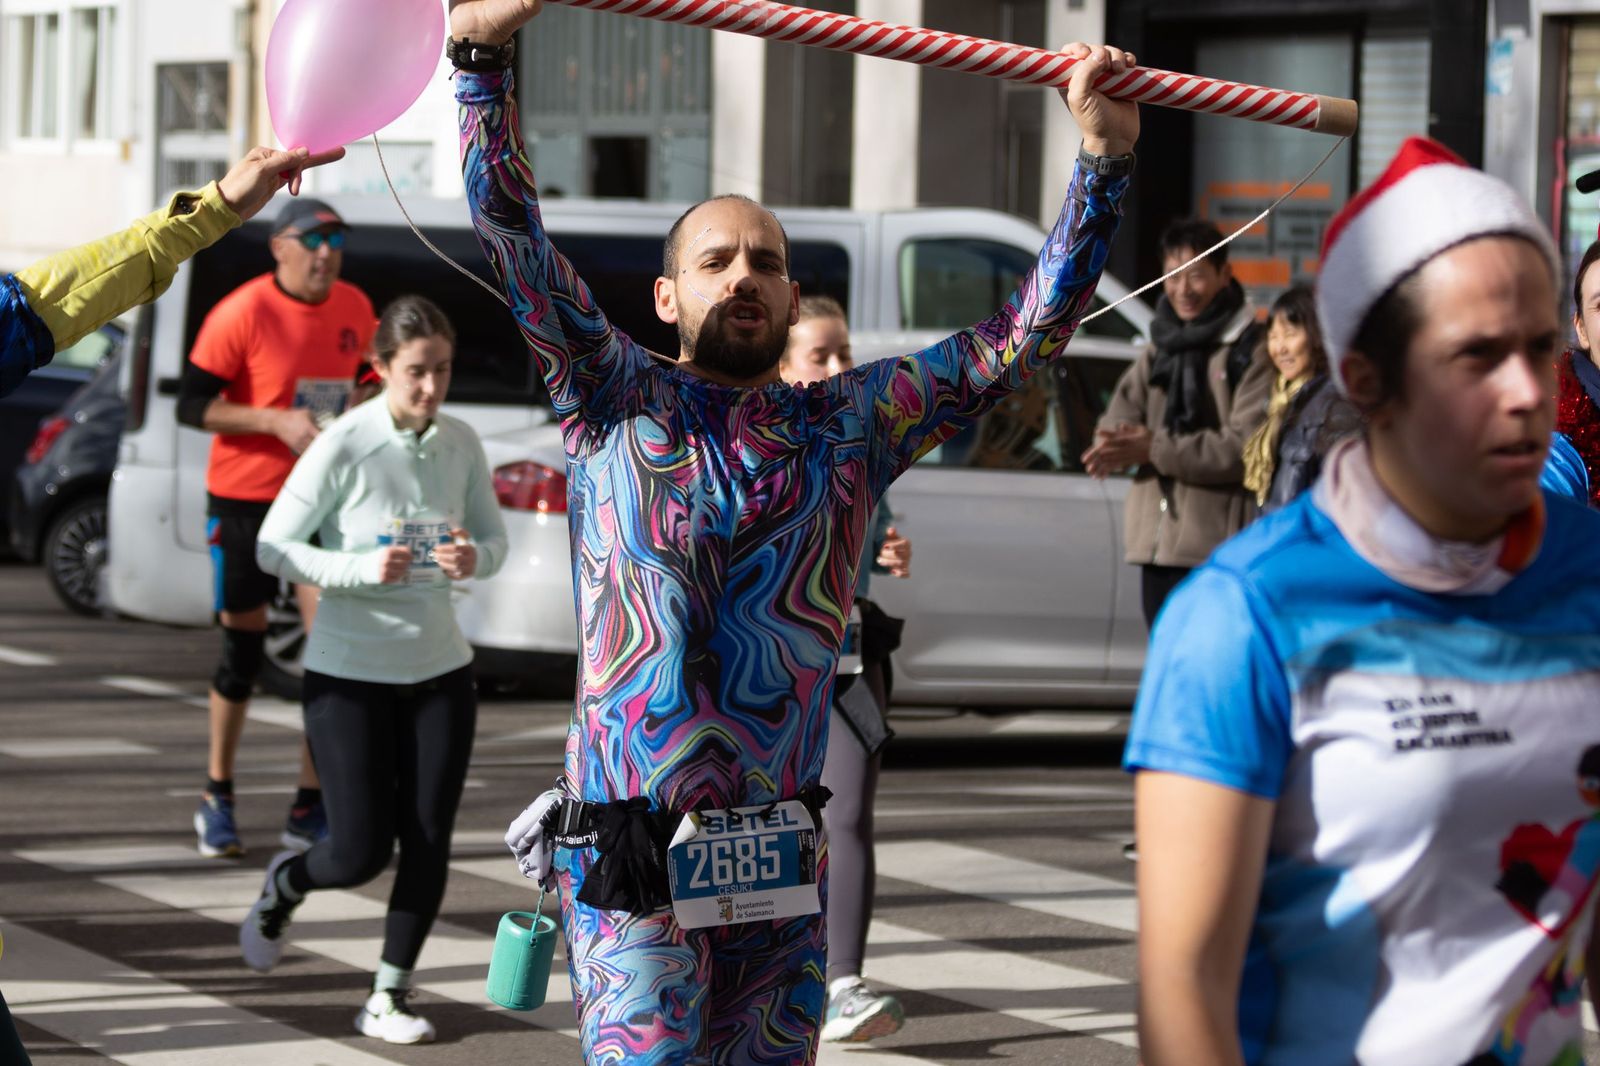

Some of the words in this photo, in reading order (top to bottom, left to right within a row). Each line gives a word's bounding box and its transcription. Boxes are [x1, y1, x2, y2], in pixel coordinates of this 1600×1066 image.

[706, 808, 799, 835] SETEL
[686, 834, 781, 890] 2685
[735, 899, 775, 911] Ayuntamiento
[735, 911, 744, 919] de
[744, 909, 775, 919] Salamanca
